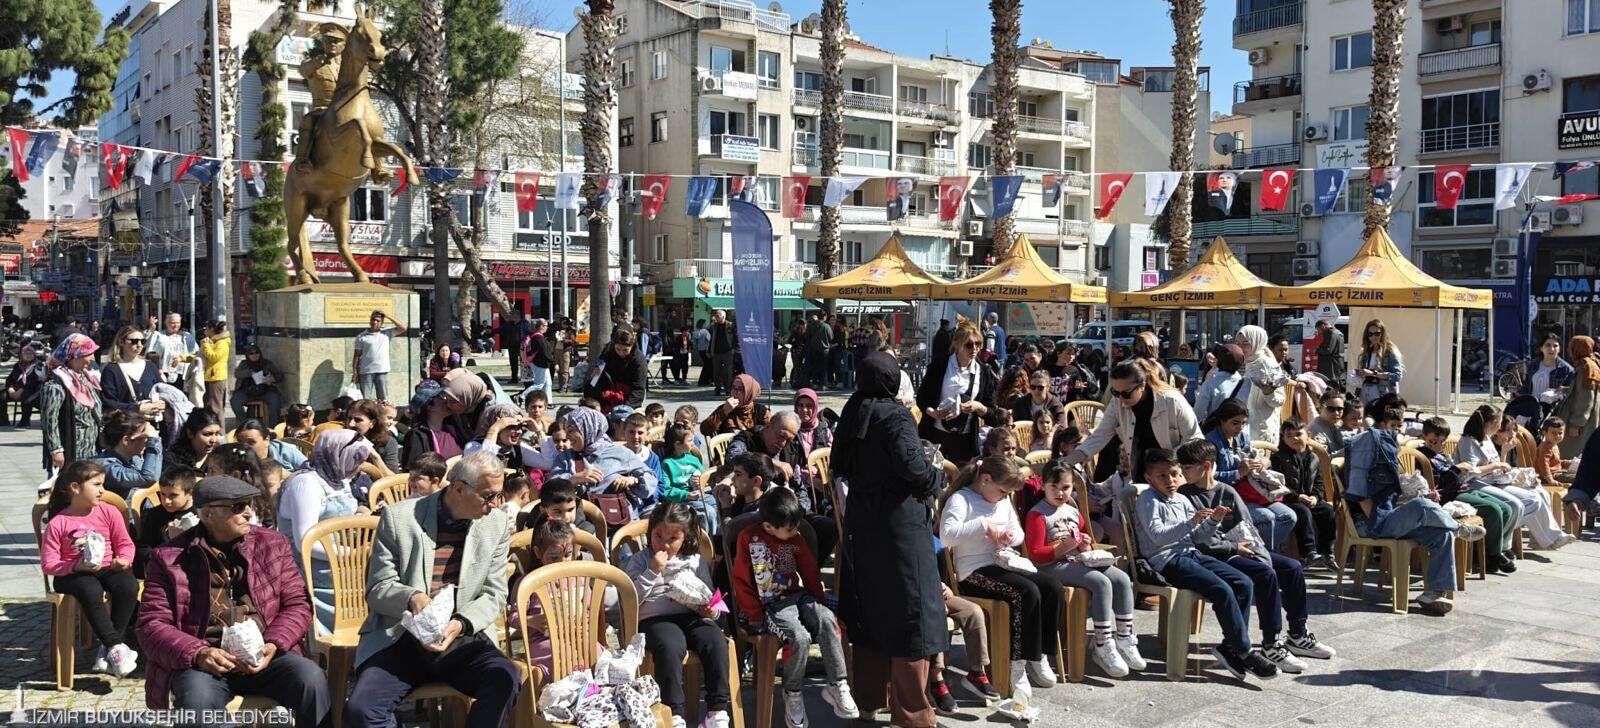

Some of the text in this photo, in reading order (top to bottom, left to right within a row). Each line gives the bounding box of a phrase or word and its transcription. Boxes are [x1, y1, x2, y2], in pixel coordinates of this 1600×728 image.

[1563, 117, 1600, 134] AVU
[839, 285, 892, 296] GENÇ İZMİR
[1546, 278, 1591, 292] ADA
[968, 286, 1028, 297] GENÇ İZMİR
[1150, 291, 1215, 302] GENÇ İZMİR
[1308, 288, 1384, 301] GENÇ İZMİR
[1557, 294, 1565, 302] A
[1568, 294, 1588, 302] Car
[842, 305, 863, 314] FOTO
